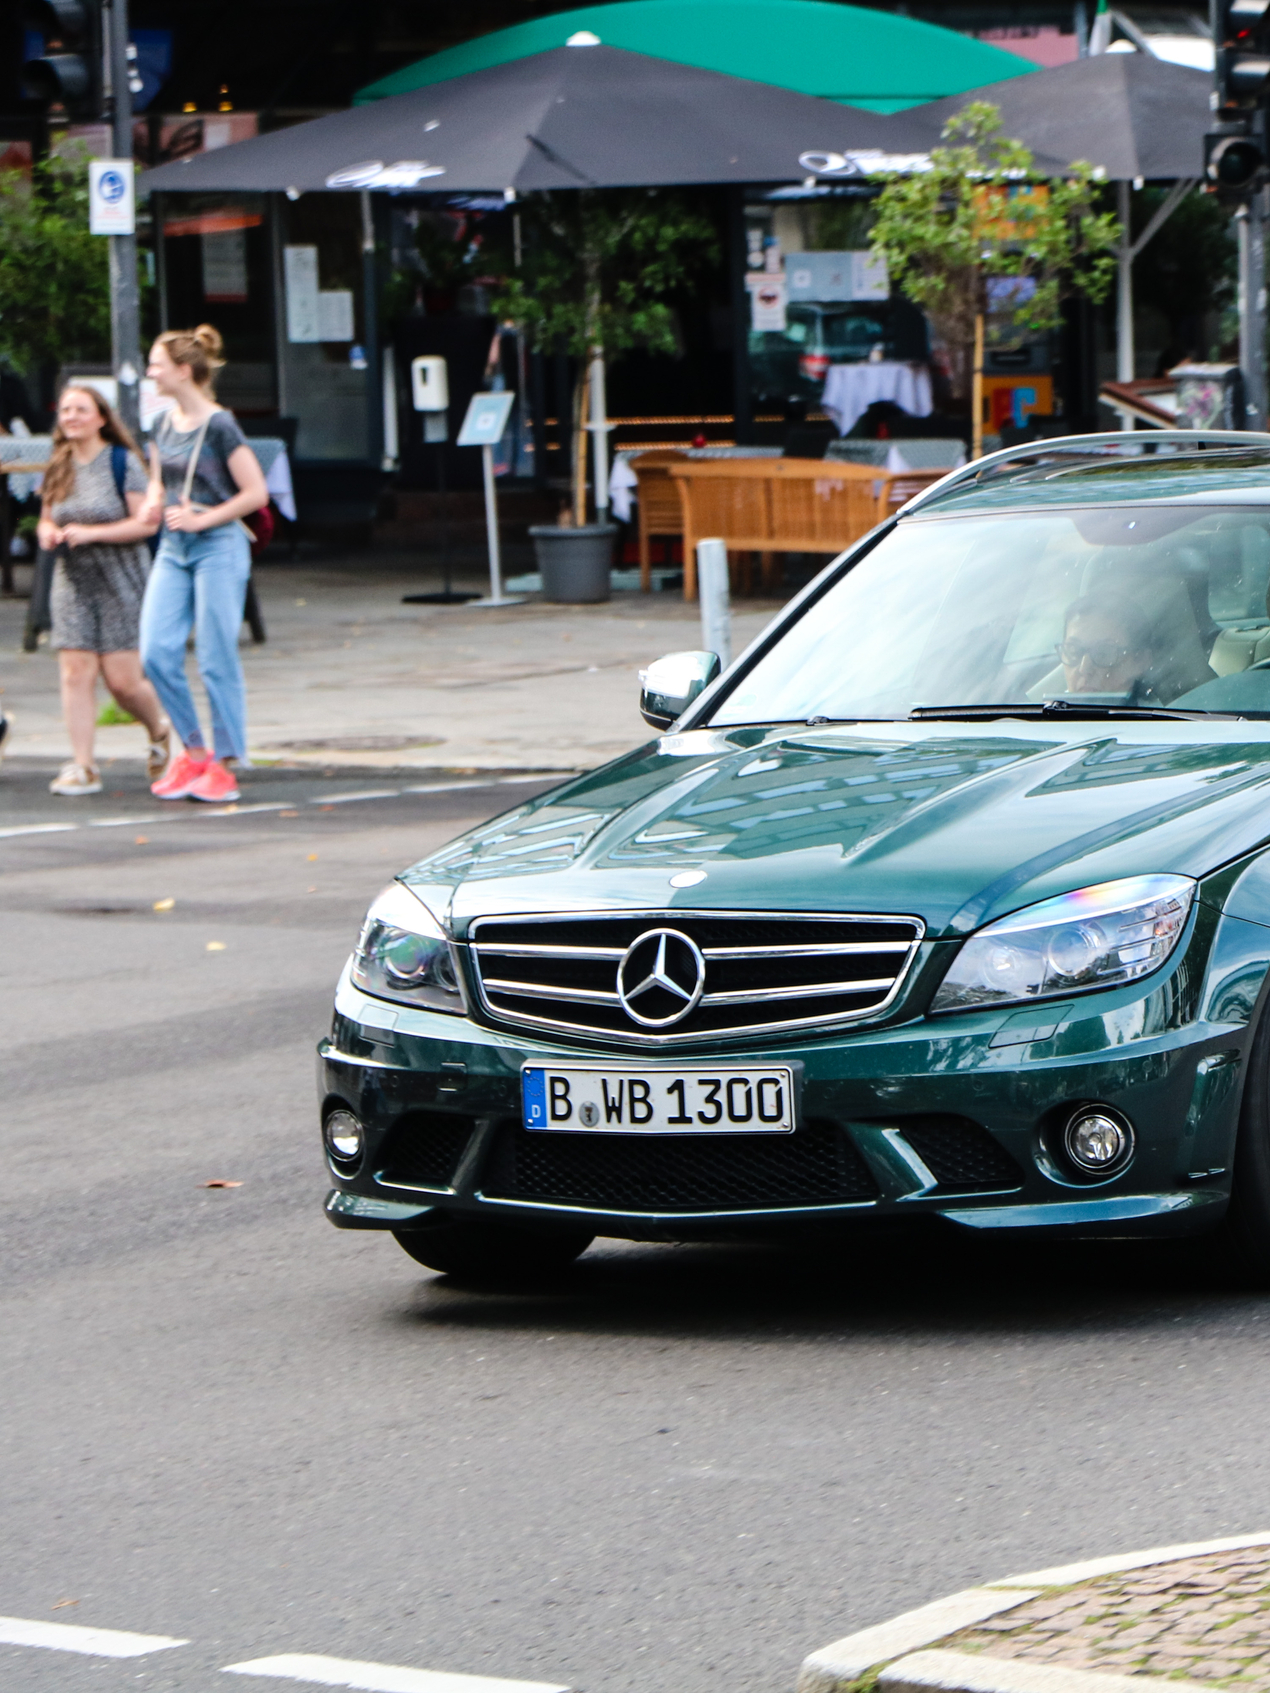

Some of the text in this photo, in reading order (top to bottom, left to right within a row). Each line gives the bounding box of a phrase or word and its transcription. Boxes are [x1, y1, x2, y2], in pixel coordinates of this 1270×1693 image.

[549, 1076, 783, 1124] B WB 1300
